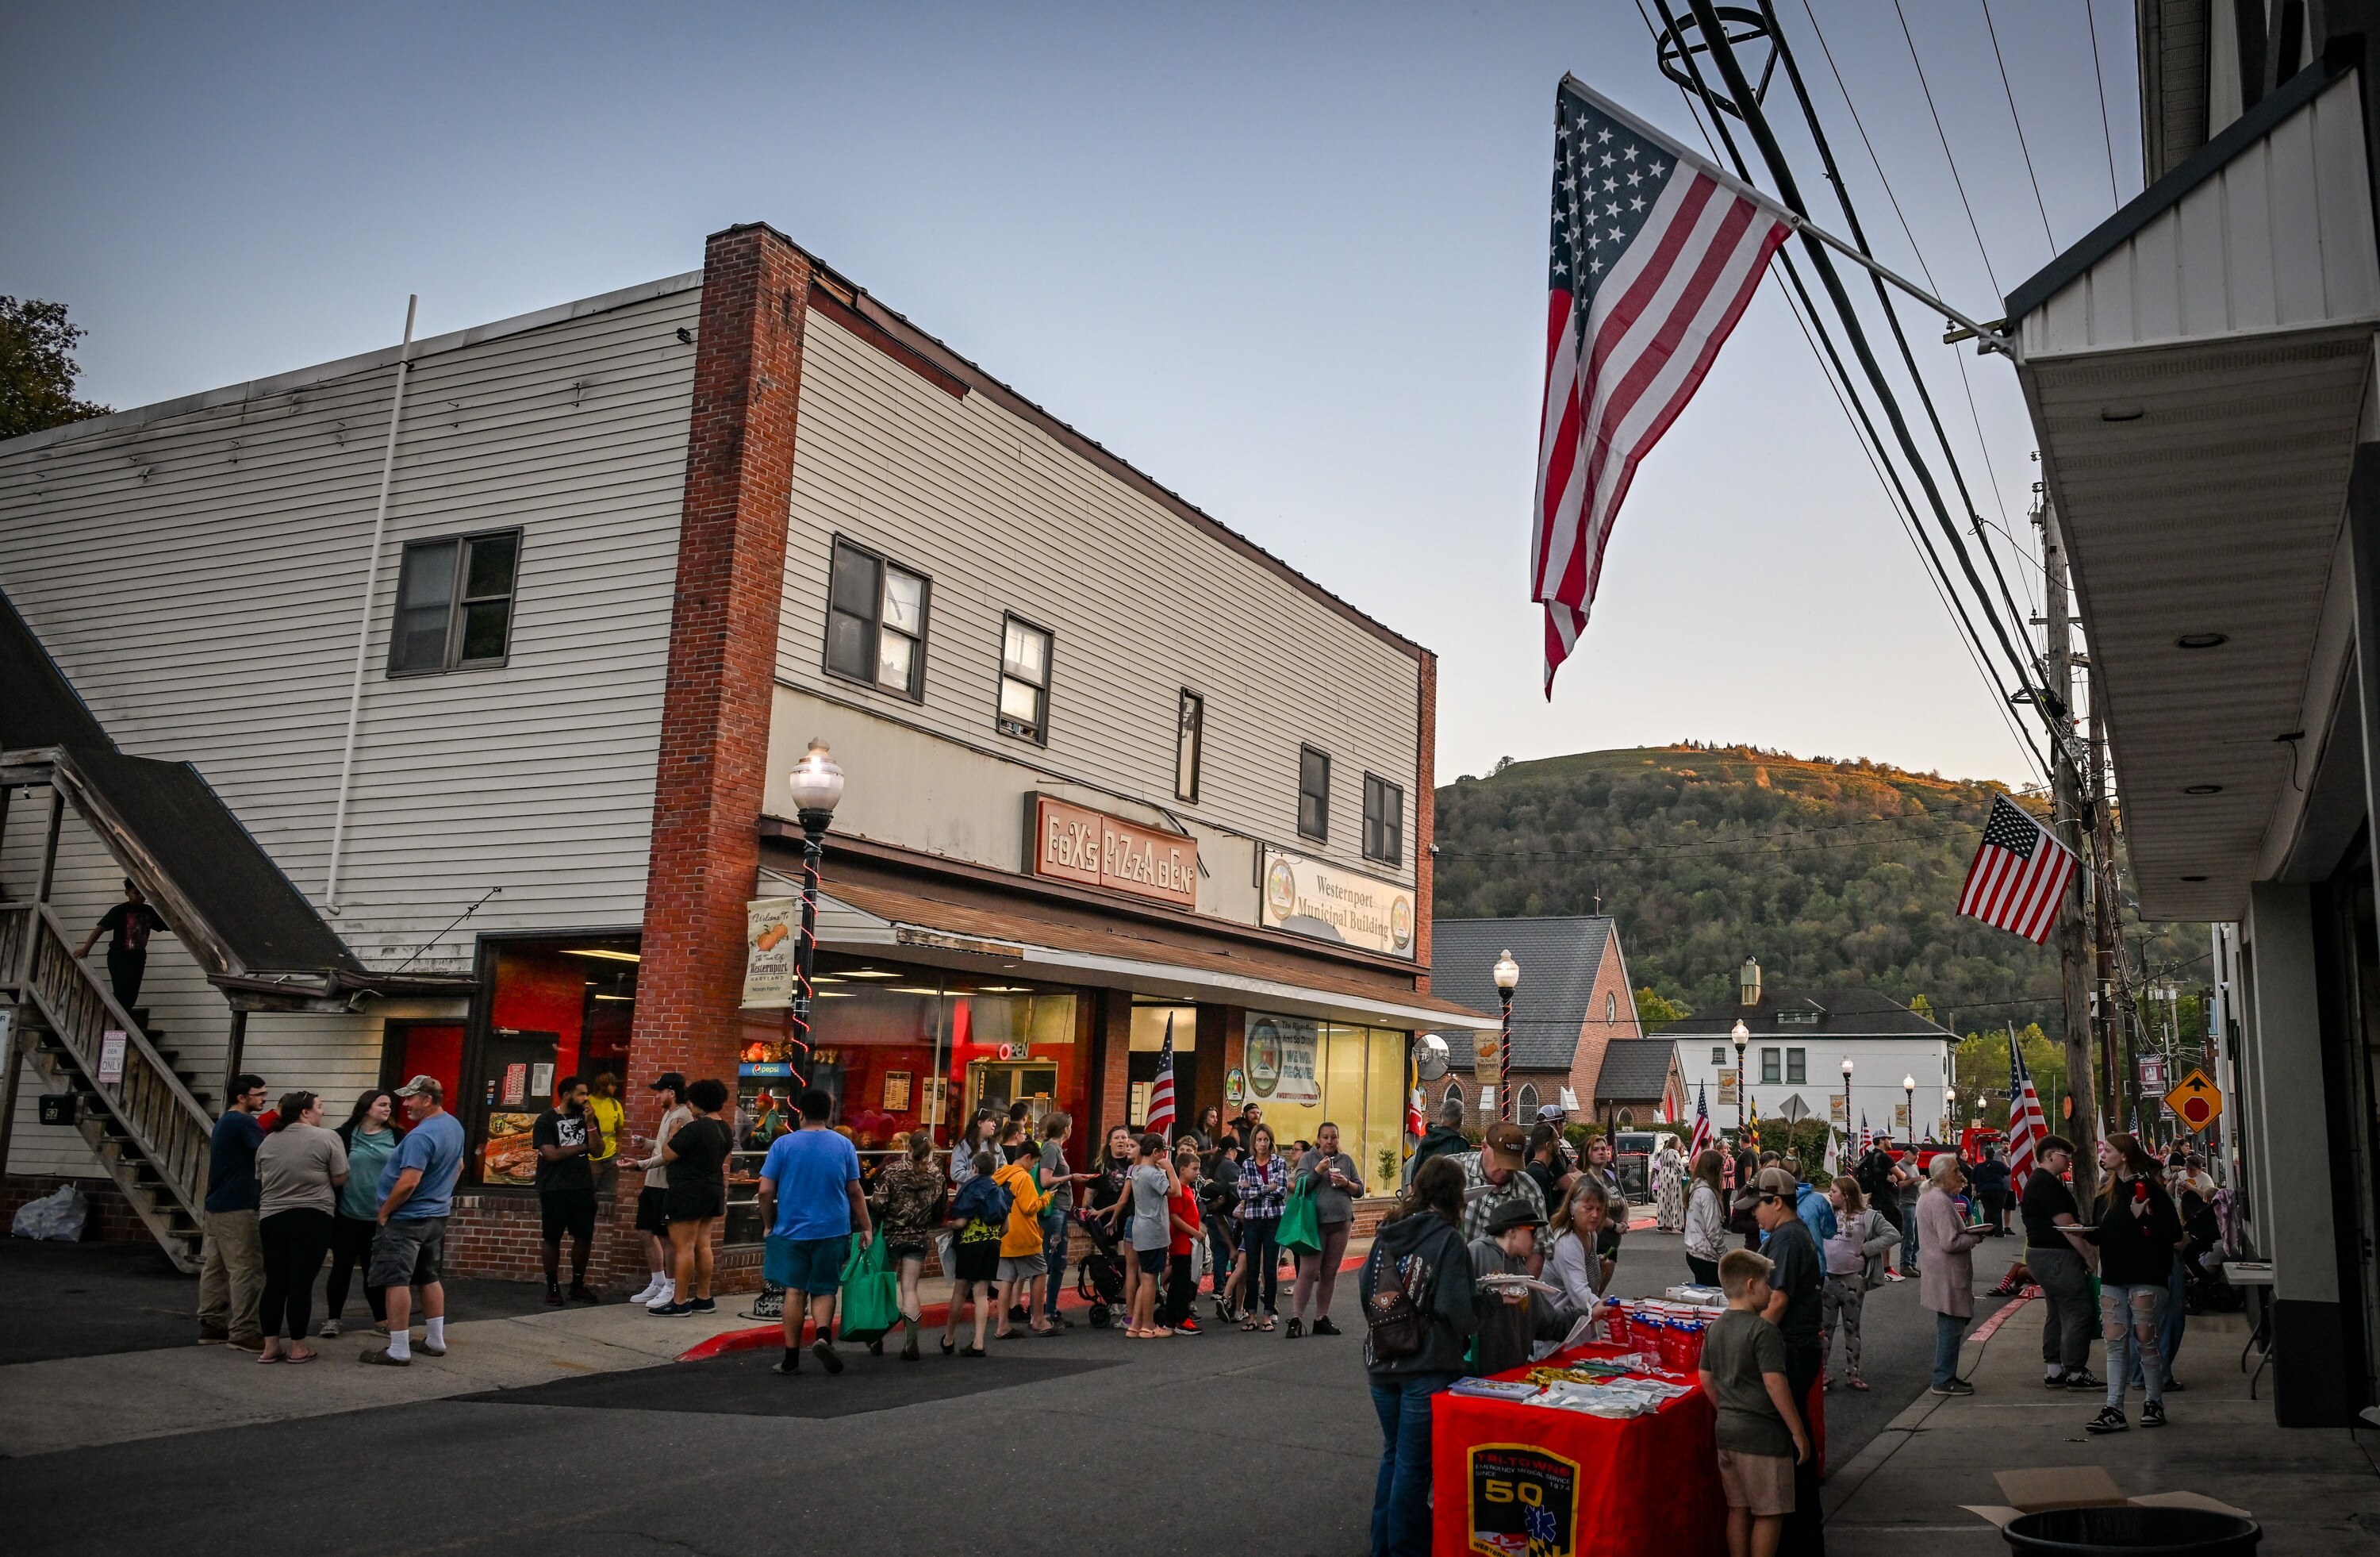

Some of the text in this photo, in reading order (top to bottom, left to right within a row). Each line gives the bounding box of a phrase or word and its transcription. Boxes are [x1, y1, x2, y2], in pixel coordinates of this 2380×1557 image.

[1103, 829, 1155, 886] PIZZA
[1157, 848, 1193, 894] DEN
[1317, 875, 1372, 908] Westernport
[753, 913, 780, 922] Welcome
[1298, 896, 1347, 929] Municipal
[1350, 910, 1388, 941] Building
[750, 963, 788, 975] Westernport
[1283, 1034, 1293, 1044] And
[999, 1041, 1029, 1060] OPEN
[1287, 1050, 1312, 1064] WE WIL
[102, 1060, 121, 1071] ONLY
[1284, 1065, 1314, 1079] RECOVE
[46, 1109, 57, 1119] 52
[1477, 1453, 1570, 1476] TRI-TOWNS
[1476, 1464, 1571, 1484] EMERGENCY MEDICAL SERVICE
[1485, 1478, 1543, 1508] 50
[1549, 1482, 1570, 1491] 1974
[1474, 1541, 1507, 1557] WESTER
